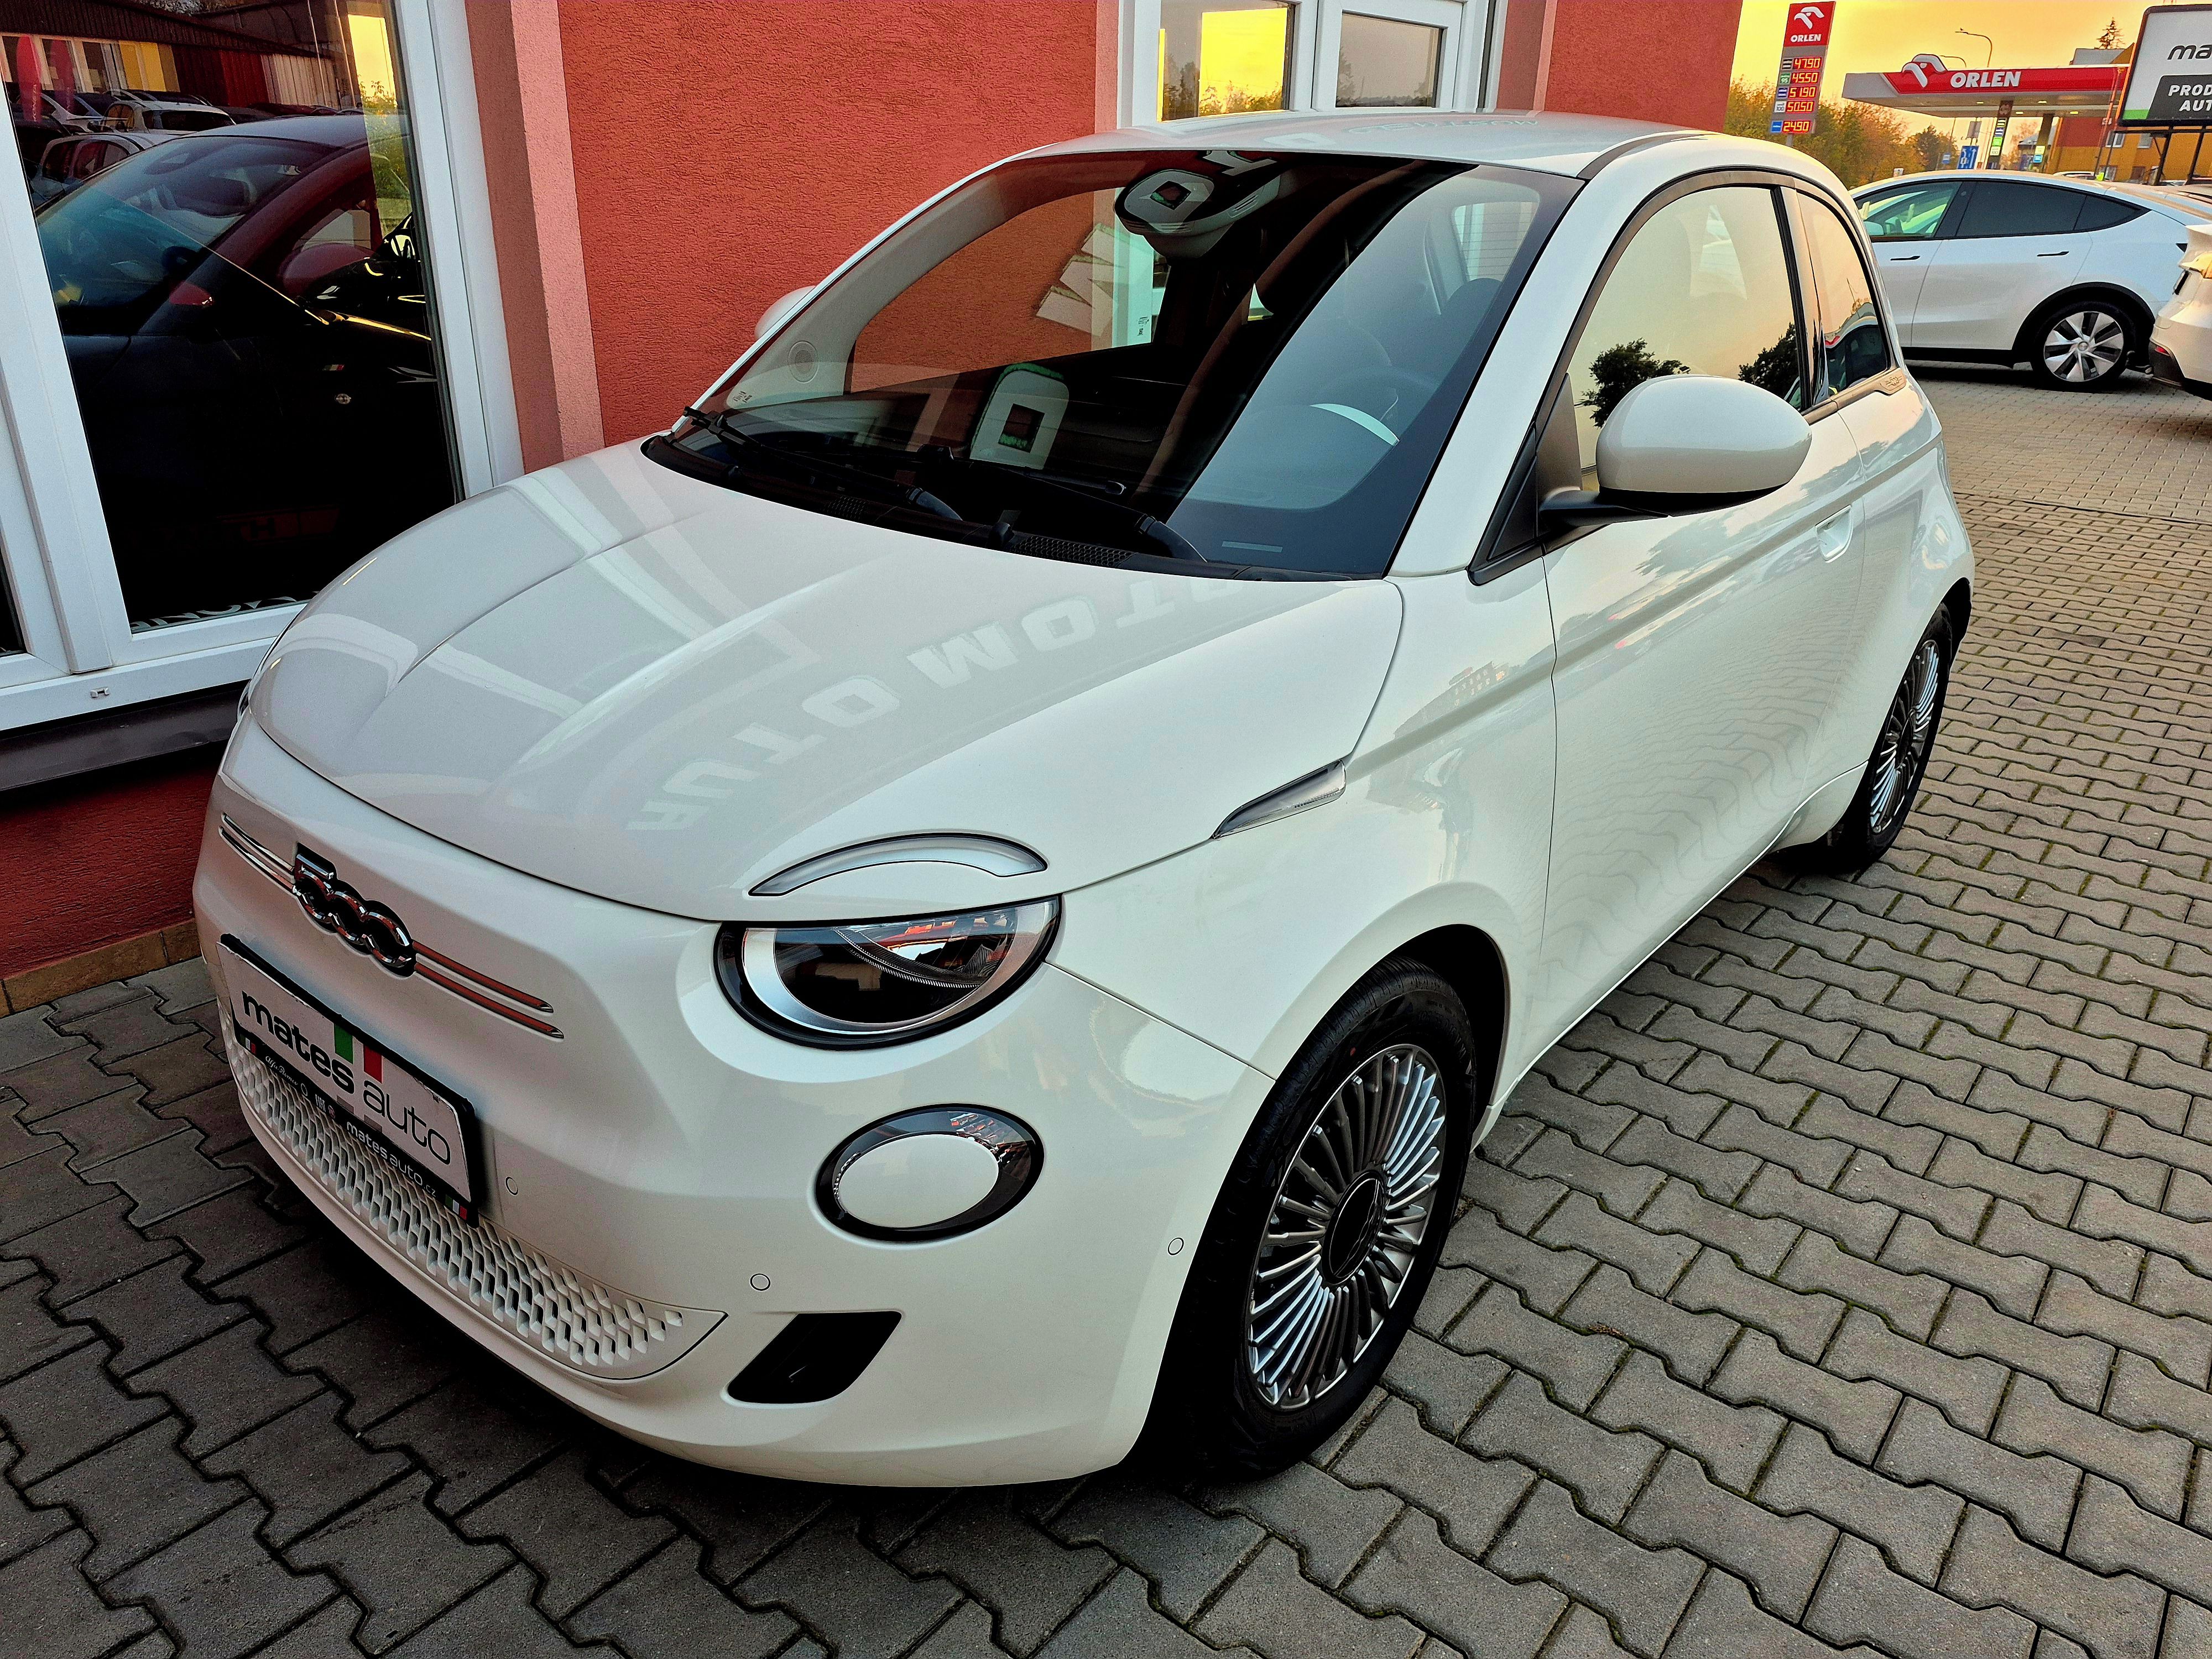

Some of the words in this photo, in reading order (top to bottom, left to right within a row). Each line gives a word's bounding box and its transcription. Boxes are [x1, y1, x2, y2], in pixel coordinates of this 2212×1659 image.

[1790, 34, 1822, 43] ORLEN
[1950, 71, 2021, 88] ORLEN
[293, 849, 414, 973] 500
[242, 990, 355, 1094] mates
[363, 1080, 451, 1165] auto
[315, 1093, 326, 1113] FIAT
